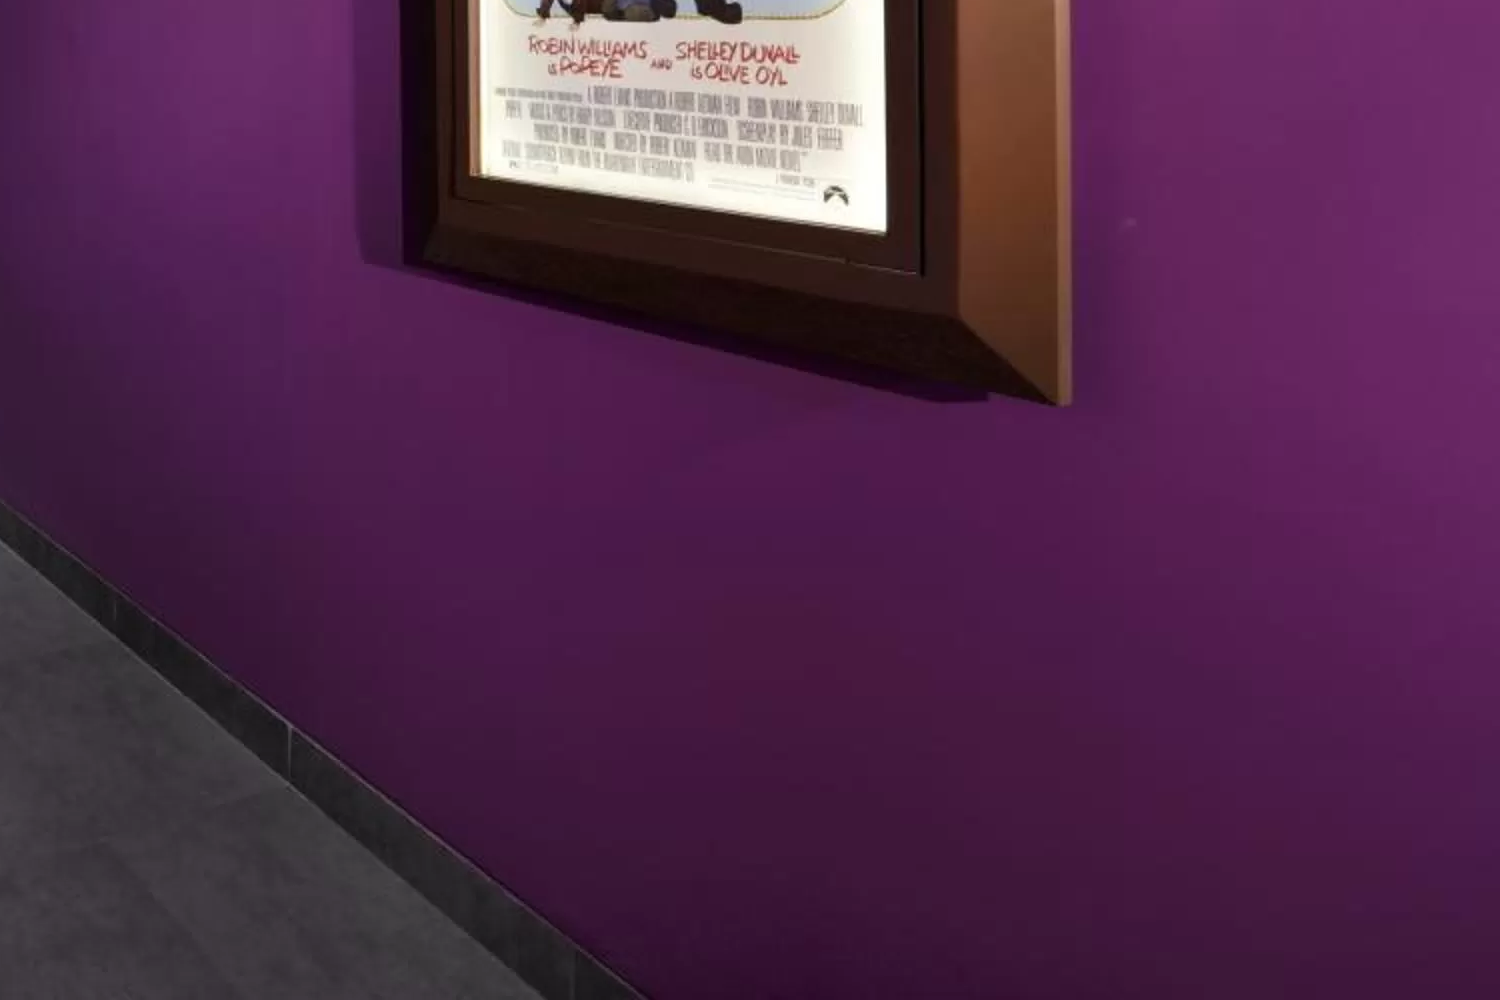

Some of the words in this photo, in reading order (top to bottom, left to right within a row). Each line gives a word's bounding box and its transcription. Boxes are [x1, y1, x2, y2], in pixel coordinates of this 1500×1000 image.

[528, 34, 575, 56] ROBIN
[578, 36, 649, 60] WILLIAMS
[675, 40, 738, 62] SHELLEY
[650, 59, 673, 71] AND
[705, 61, 751, 85] OLIVE
[755, 65, 789, 87] OYL
